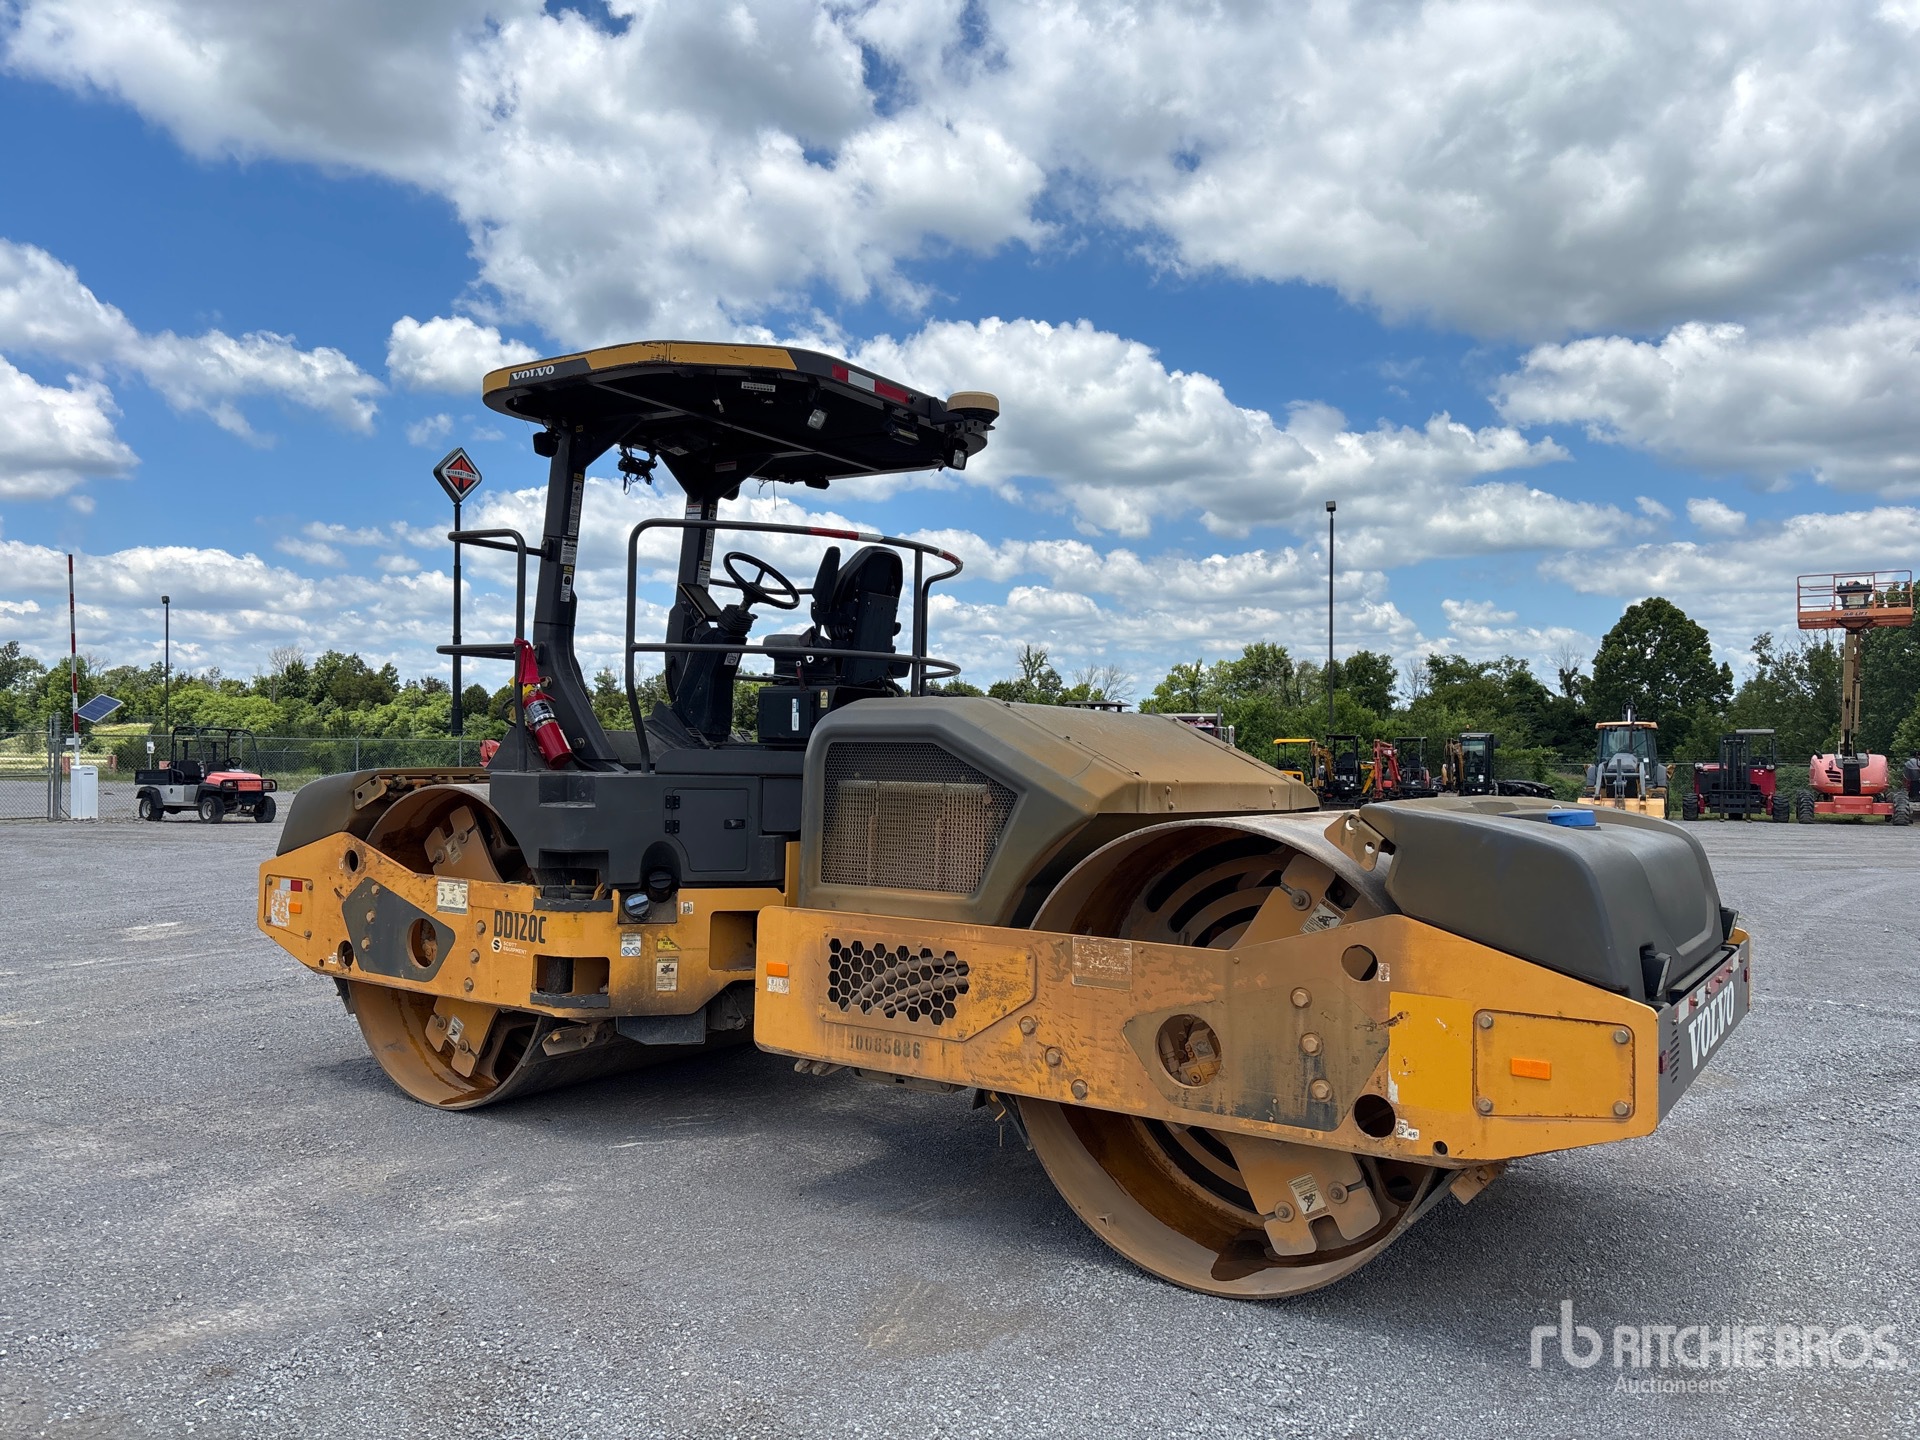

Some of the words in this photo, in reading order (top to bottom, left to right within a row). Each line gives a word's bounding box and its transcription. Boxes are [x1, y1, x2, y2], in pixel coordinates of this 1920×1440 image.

[511, 365, 555, 380] VOLVO
[494, 910, 546, 944] DD120C
[1688, 981, 1735, 1070] VOLVO
